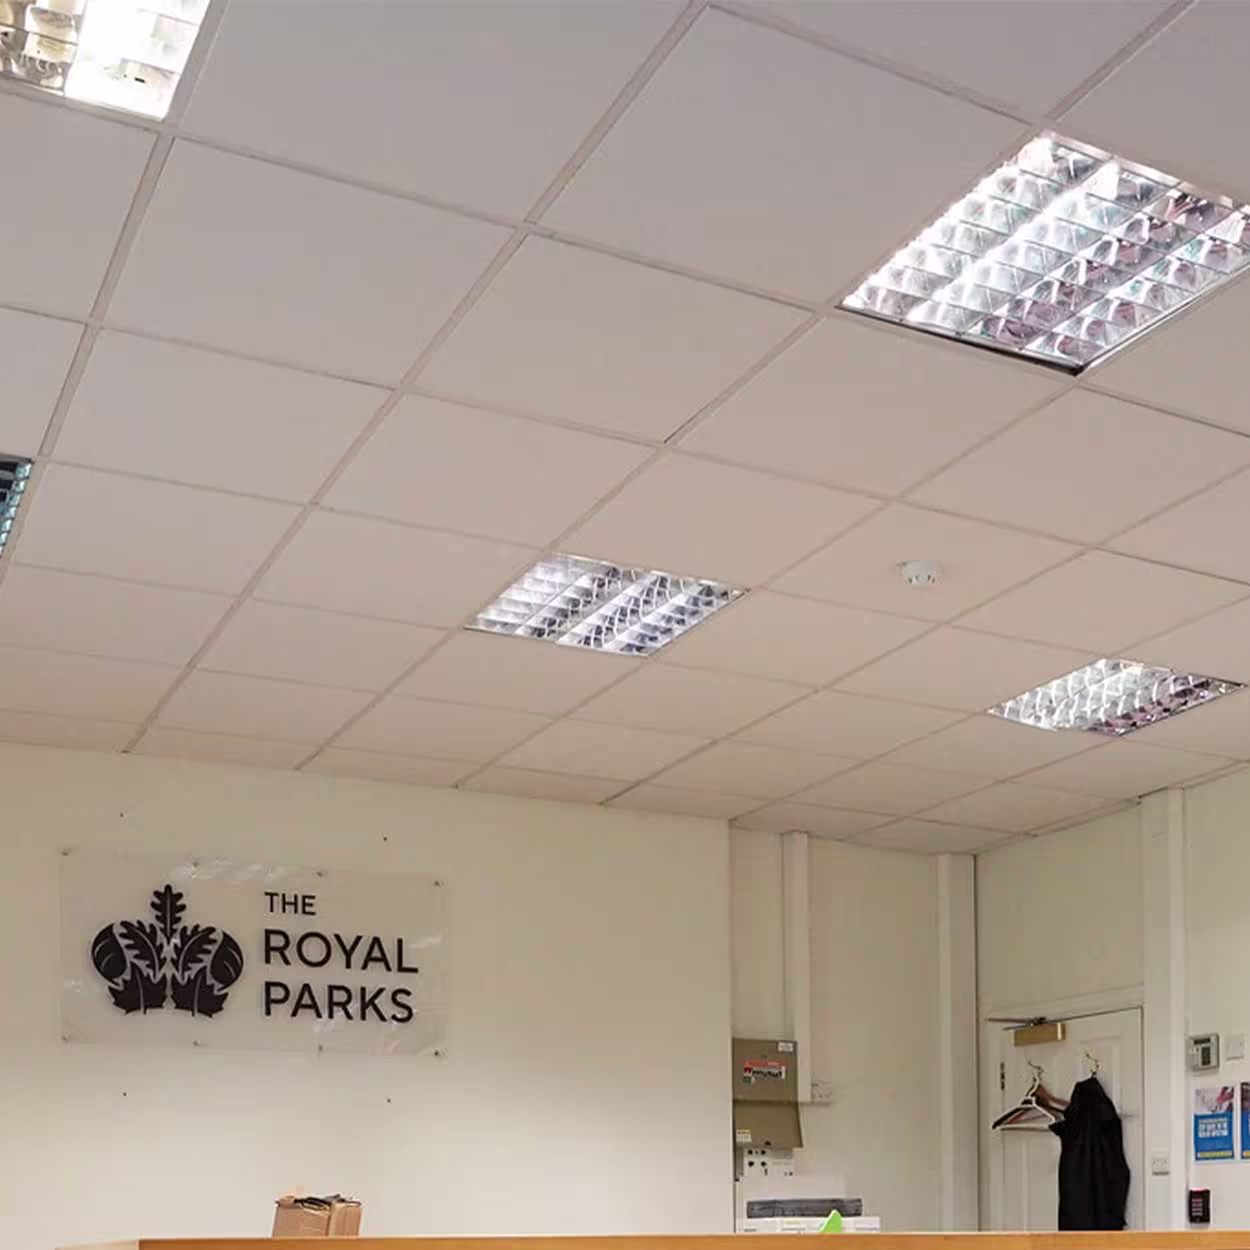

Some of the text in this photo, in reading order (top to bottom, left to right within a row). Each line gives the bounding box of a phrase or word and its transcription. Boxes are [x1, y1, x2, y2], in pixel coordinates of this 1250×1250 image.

[263, 891, 317, 916] THE
[264, 928, 419, 974] ROYAL
[264, 980, 415, 1024] PARKS
